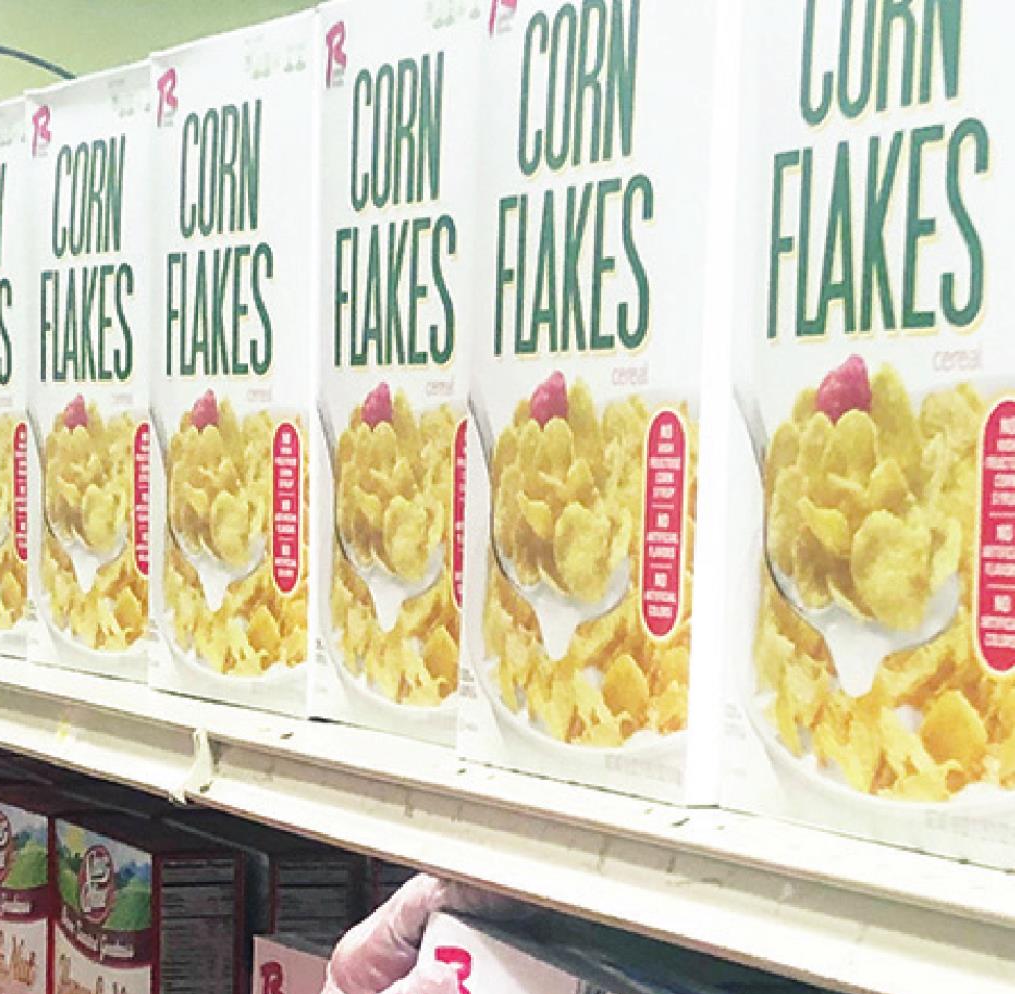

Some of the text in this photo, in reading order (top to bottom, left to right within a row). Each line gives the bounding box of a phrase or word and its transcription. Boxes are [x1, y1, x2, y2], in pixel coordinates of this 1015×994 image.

[351, 52, 444, 211] CORN
[519, 0, 638, 176] CORN
[800, 0, 964, 125] CORN
[52, 135, 125, 258] CORN
[180, 100, 262, 238] CORN
[767, 117, 989, 339] FLAKES
[40, 263, 134, 383] FLAKES
[167, 242, 274, 376] FLAKES
[335, 214, 457, 367] FLAKES
[494, 173, 654, 356] FLAKES
